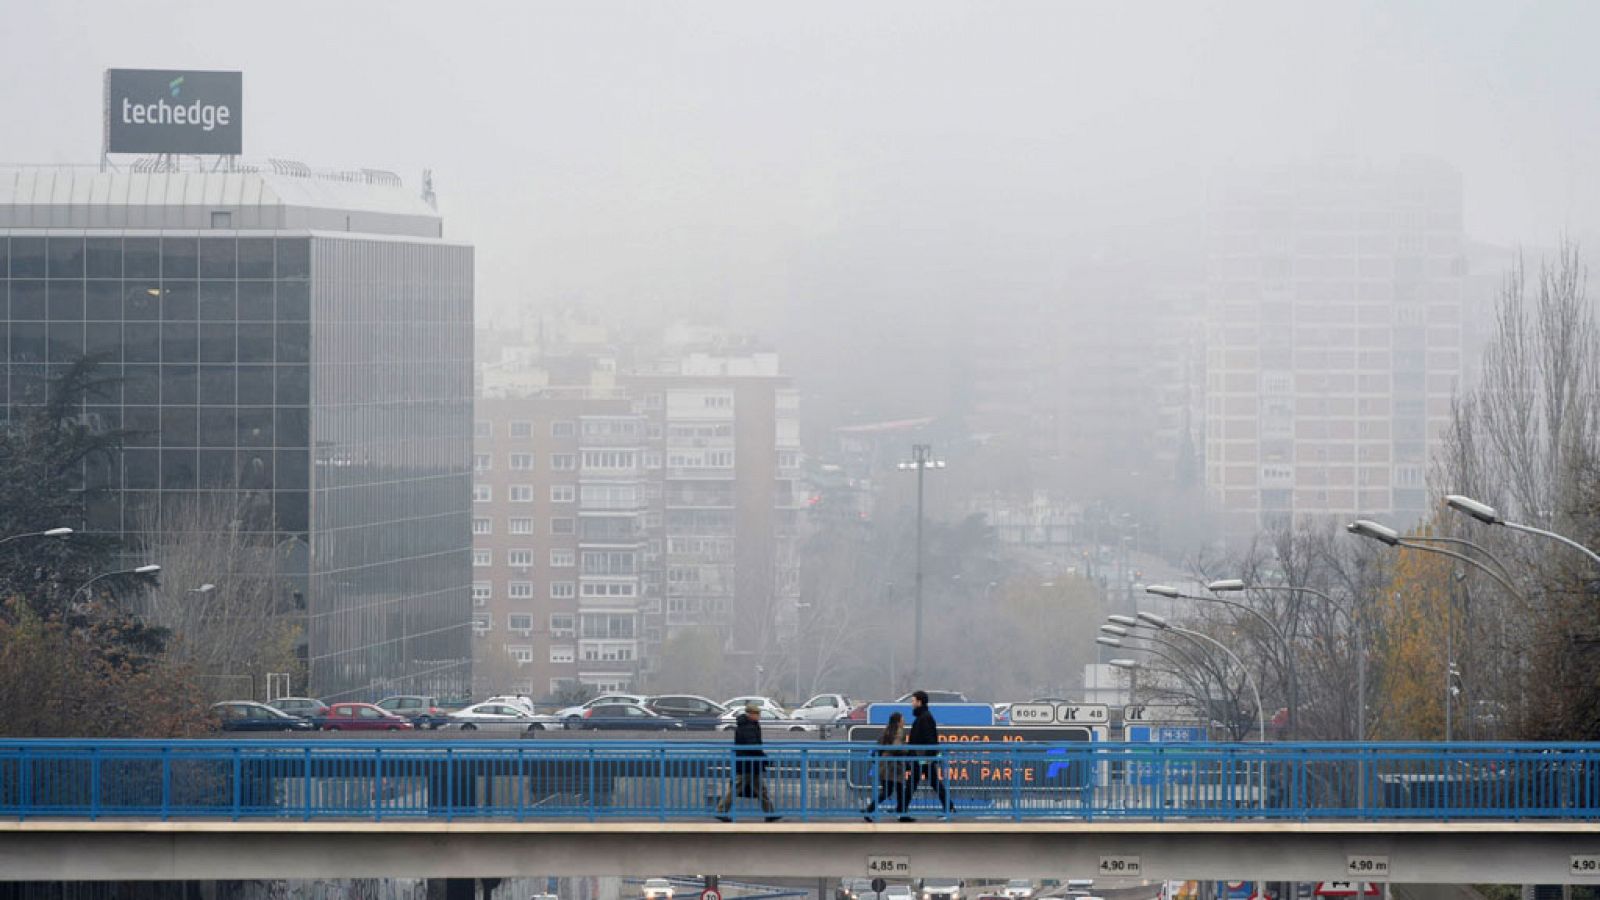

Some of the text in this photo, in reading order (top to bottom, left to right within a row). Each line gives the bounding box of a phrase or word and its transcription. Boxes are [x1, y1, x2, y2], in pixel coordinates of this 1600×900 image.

[122, 97, 229, 131] techedge
[870, 860, 893, 872] 4,85
[1100, 860, 1124, 872] 4,90
[1350, 860, 1373, 872] 4,90
[1572, 860, 1596, 871] 4,90
